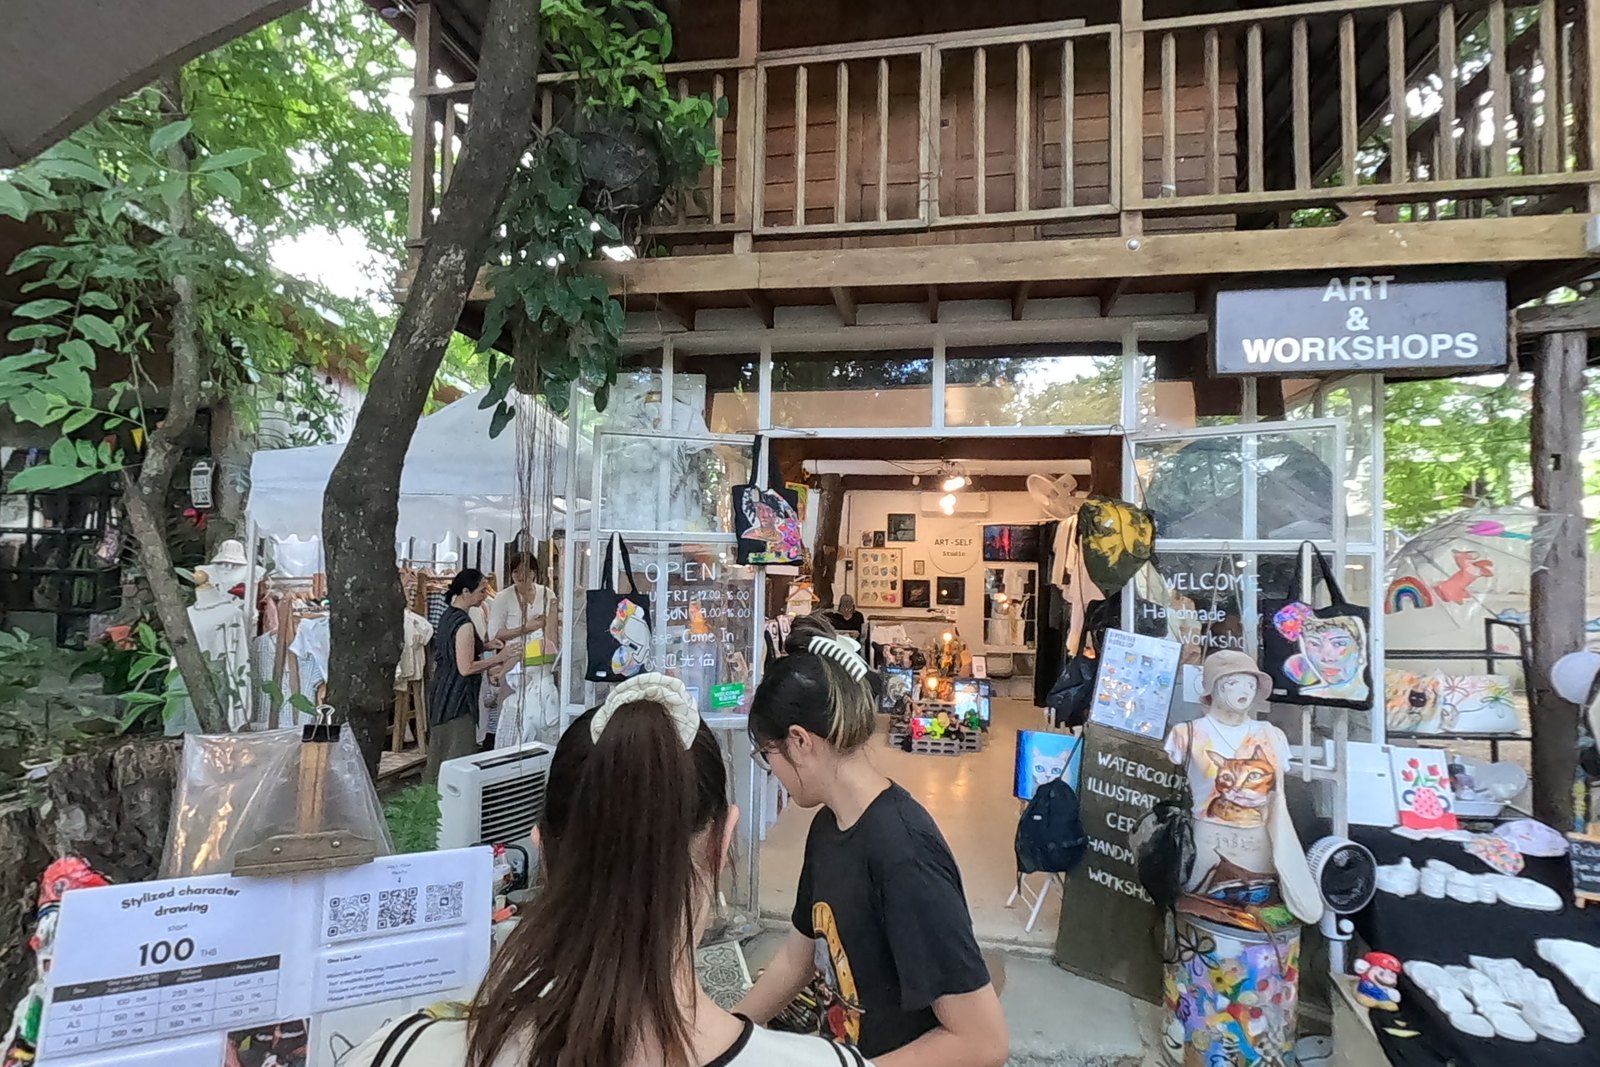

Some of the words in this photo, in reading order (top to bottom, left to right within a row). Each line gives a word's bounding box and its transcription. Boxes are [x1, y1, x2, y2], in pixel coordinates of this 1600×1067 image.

[1322, 275, 1395, 302] ART
[1346, 306, 1370, 331] &
[1241, 332, 1479, 364] WORKSHOPS
[645, 562, 716, 583] OPEN
[1161, 572, 1262, 591] WELCOME
[663, 608, 688, 622] SUN
[1142, 603, 1226, 622] Handmade
[682, 629, 716, 644] Come
[720, 627, 735, 643] In
[121, 887, 175, 910] Stylized
[178, 885, 241, 898] character
[154, 902, 209, 918] drawing
[139, 937, 195, 967] 100
